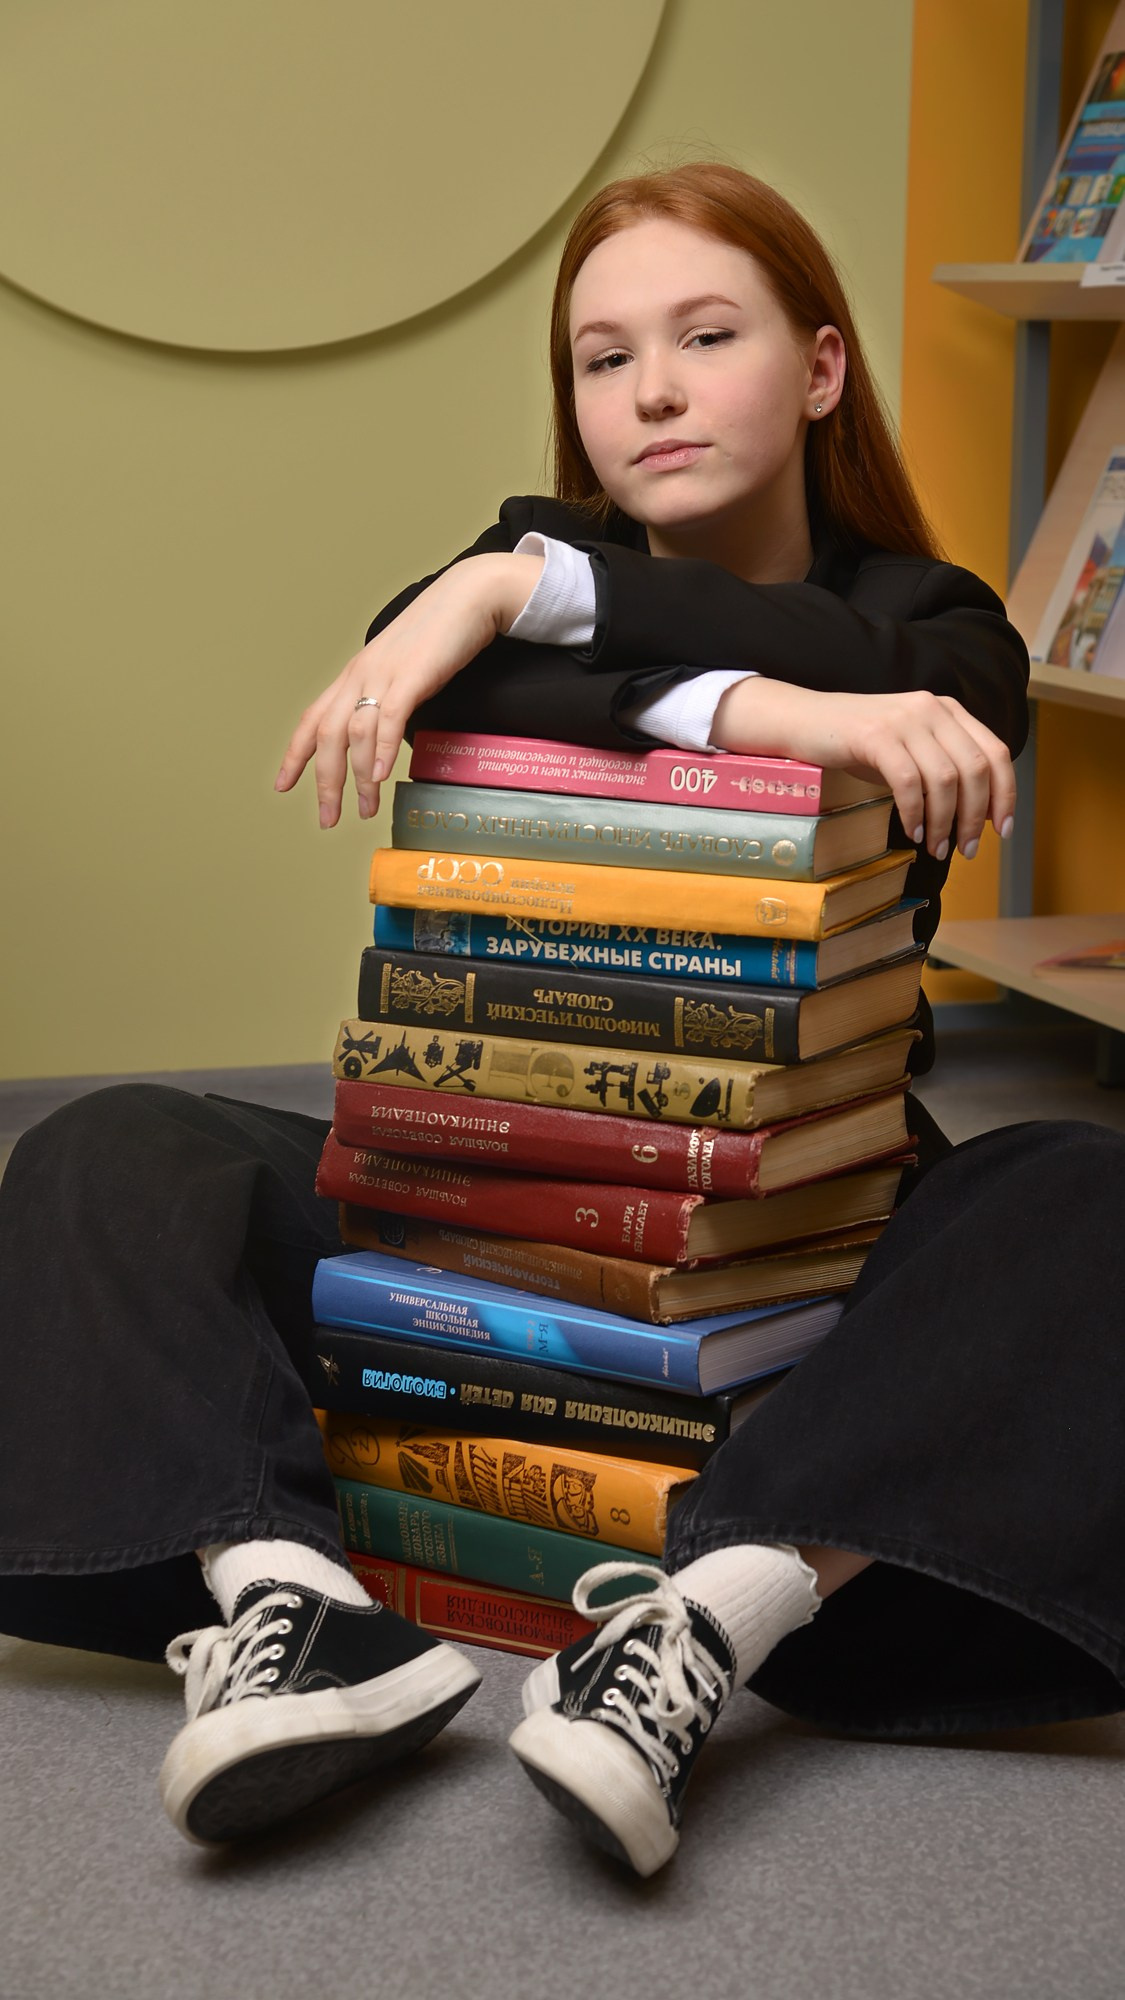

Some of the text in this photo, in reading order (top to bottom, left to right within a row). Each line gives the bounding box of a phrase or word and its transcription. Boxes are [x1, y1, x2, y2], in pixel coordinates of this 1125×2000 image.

[426, 742, 648, 772] из всеобщей и отечественной истории
[476, 760, 648, 787] знаменитых имен и событий
[670, 766, 719, 794] 400
[407, 809, 765, 860] СЛОВАРЬ ИНОСТРАННЫХ СЛОВ
[417, 856, 505, 887] СССР
[416, 885, 574, 915] Иллюстрированная
[505, 916, 611, 940] ИСТОРИЯ
[486, 937, 742, 978] ЗАРУБЕЖНЫЕ СТРАНЫ
[533, 988, 614, 1012] СЛОВАРЬ
[486, 1001, 661, 1038] МИФОЛОГИЧЕСКИЙ
[370, 1105, 510, 1134] ЭНЦИКЛОПЕДИЯ
[371, 1126, 509, 1152] БОЛЬШАЯ СОВЕТСКАЯ
[631, 1143, 659, 1164] 6
[352, 1151, 472, 1187] ЭНЦИКЛОПЕДИЯ
[686, 1129, 701, 1188] ГАЗЛИФТ
[348, 1171, 467, 1207] БОЛЬШАЯ СОВЕТСКАЯ
[574, 1207, 600, 1229] 3
[621, 1204, 635, 1243] БАРИ
[633, 1199, 648, 1253] БРАСЛЕТ
[438, 1229, 479, 1252] СЛОВАРЬ
[463, 1253, 561, 1291] ГЕОГРАФИЧЕСКИЙ
[389, 1292, 469, 1316] УНИВЕРСАЛЬНАЯ
[425, 1309, 479, 1328] ШКОЛЬНАЯ
[412, 1317, 491, 1342] ЭНЦИКЛОПЕДИЯ
[362, 1368, 447, 1399] БИОЛОГИЯ
[459, 1383, 716, 1443] ЭНЦИКЛОПЕДИЯ ДЛЯ ДЕТЕЙ
[610, 1507, 631, 1526] 8
[447, 1595, 574, 1632] ЭНЦИКЛОПЕДИЯ
[447, 1609, 574, 1647] ЛЕРМОНТОВСКАЯ
